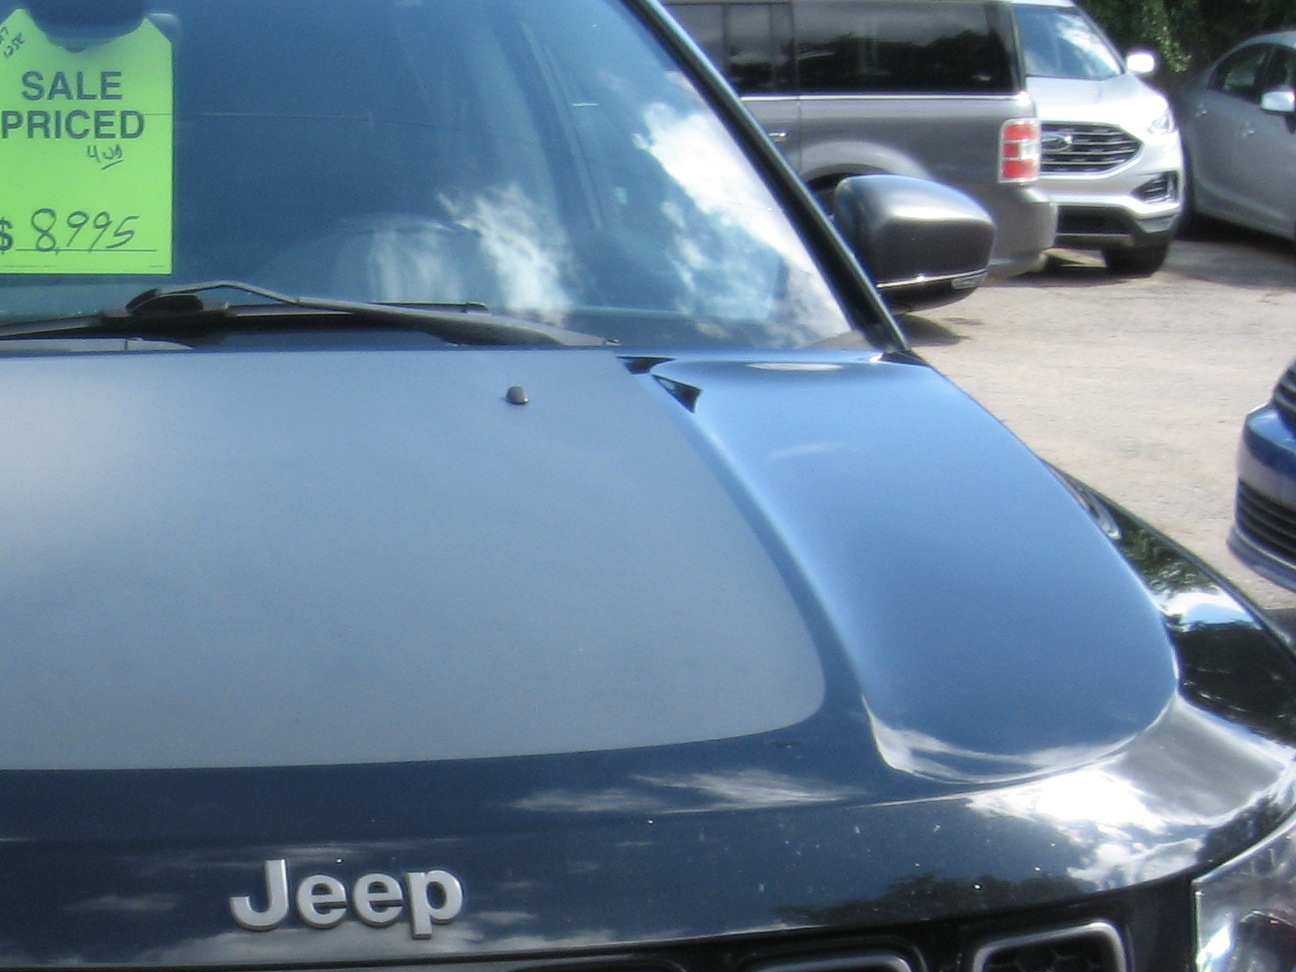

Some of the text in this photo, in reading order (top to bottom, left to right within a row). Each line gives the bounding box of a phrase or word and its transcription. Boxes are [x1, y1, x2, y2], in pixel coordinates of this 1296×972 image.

[21, 71, 122, 100] SALE
[1, 109, 145, 139] PRICED
[229, 859, 463, 940] Jeep
